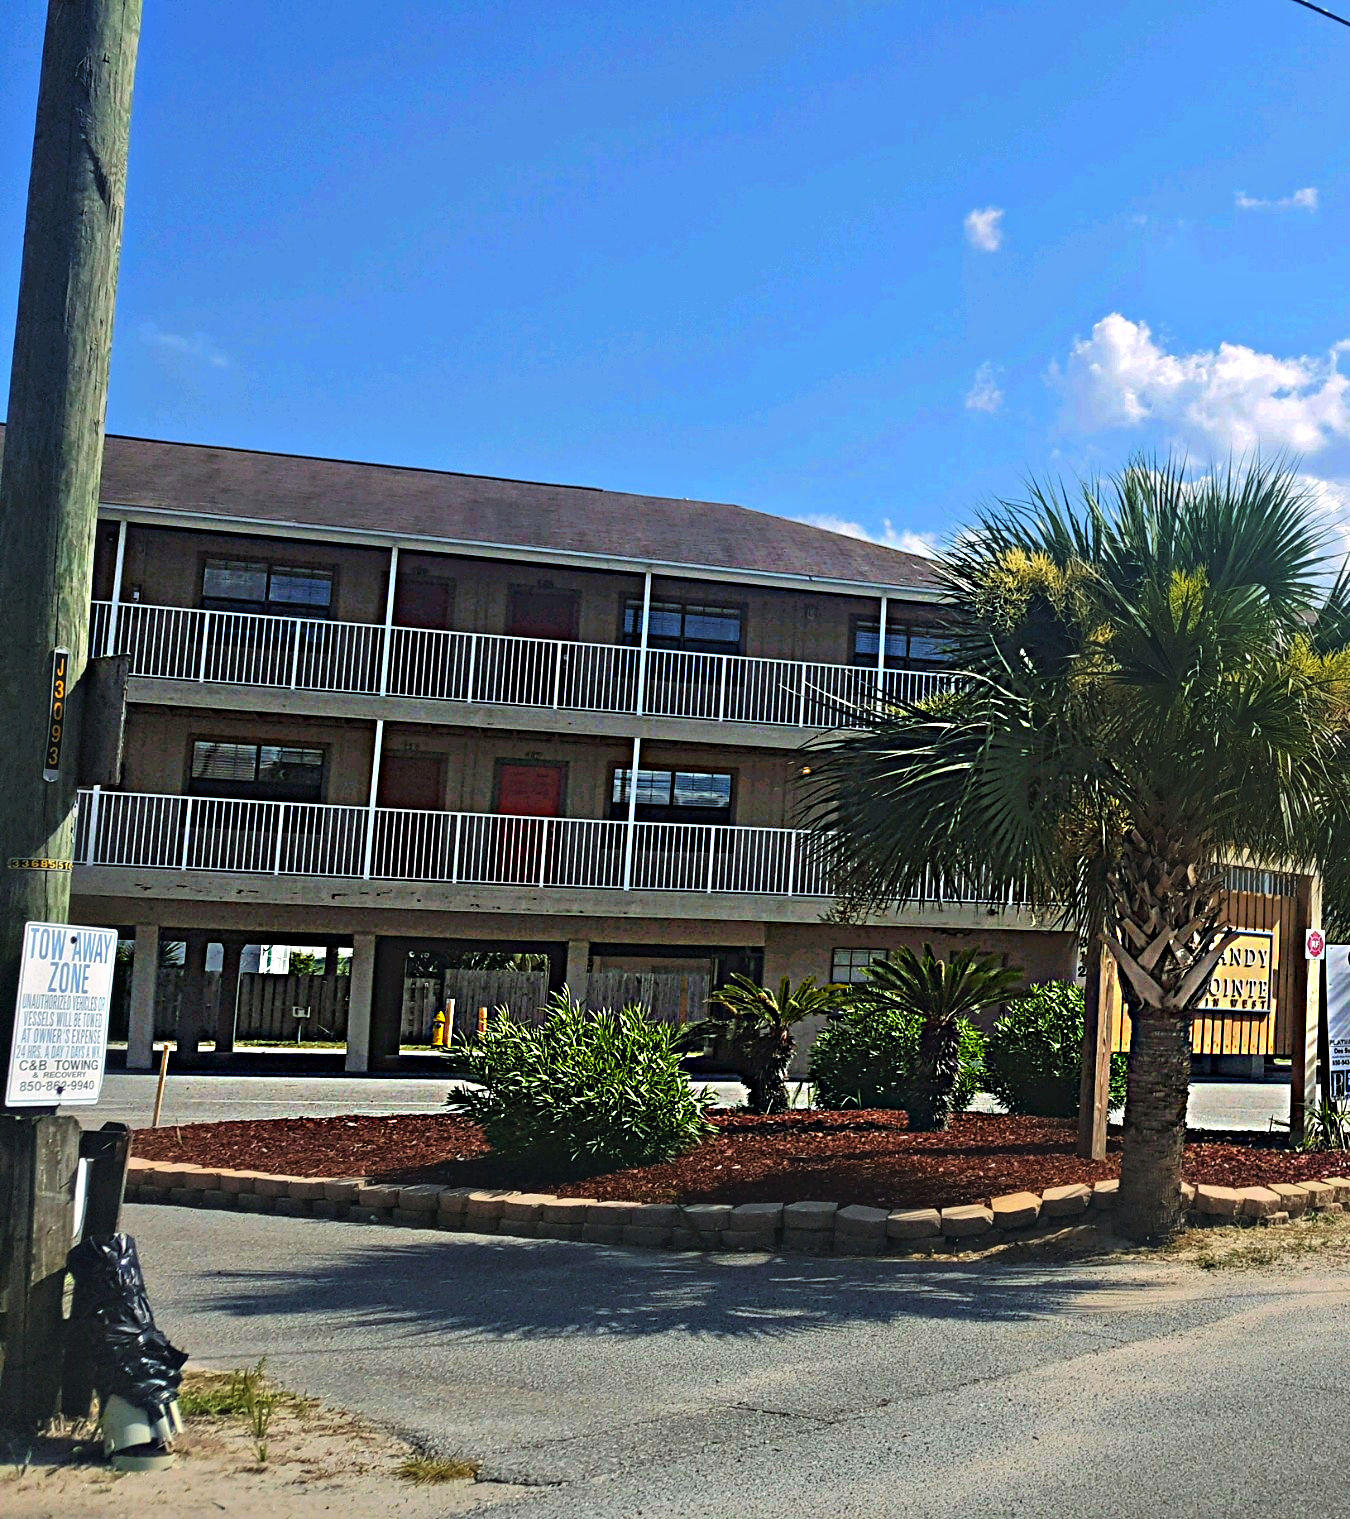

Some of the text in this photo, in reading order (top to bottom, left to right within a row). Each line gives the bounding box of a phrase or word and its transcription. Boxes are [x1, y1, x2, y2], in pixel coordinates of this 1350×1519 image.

[47, 658, 66, 765] J3093
[31, 927, 113, 964] TOW AWAY
[1218, 947, 1267, 968] ANDY
[47, 961, 91, 994] ZONE
[1207, 978, 1268, 999] OINTE
[22, 993, 71, 1011] UNAUTHORIZED
[72, 995, 97, 1012] VEHICLES
[1229, 999, 1267, 1010] WEST
[23, 1011, 103, 1028] VESSELS WILL BE TOWED
[21, 1027, 102, 1045] AT OWNER'S EXPENSE
[19, 1059, 99, 1072] C&B TOWING
[42, 1071, 87, 1079] RECOVERY
